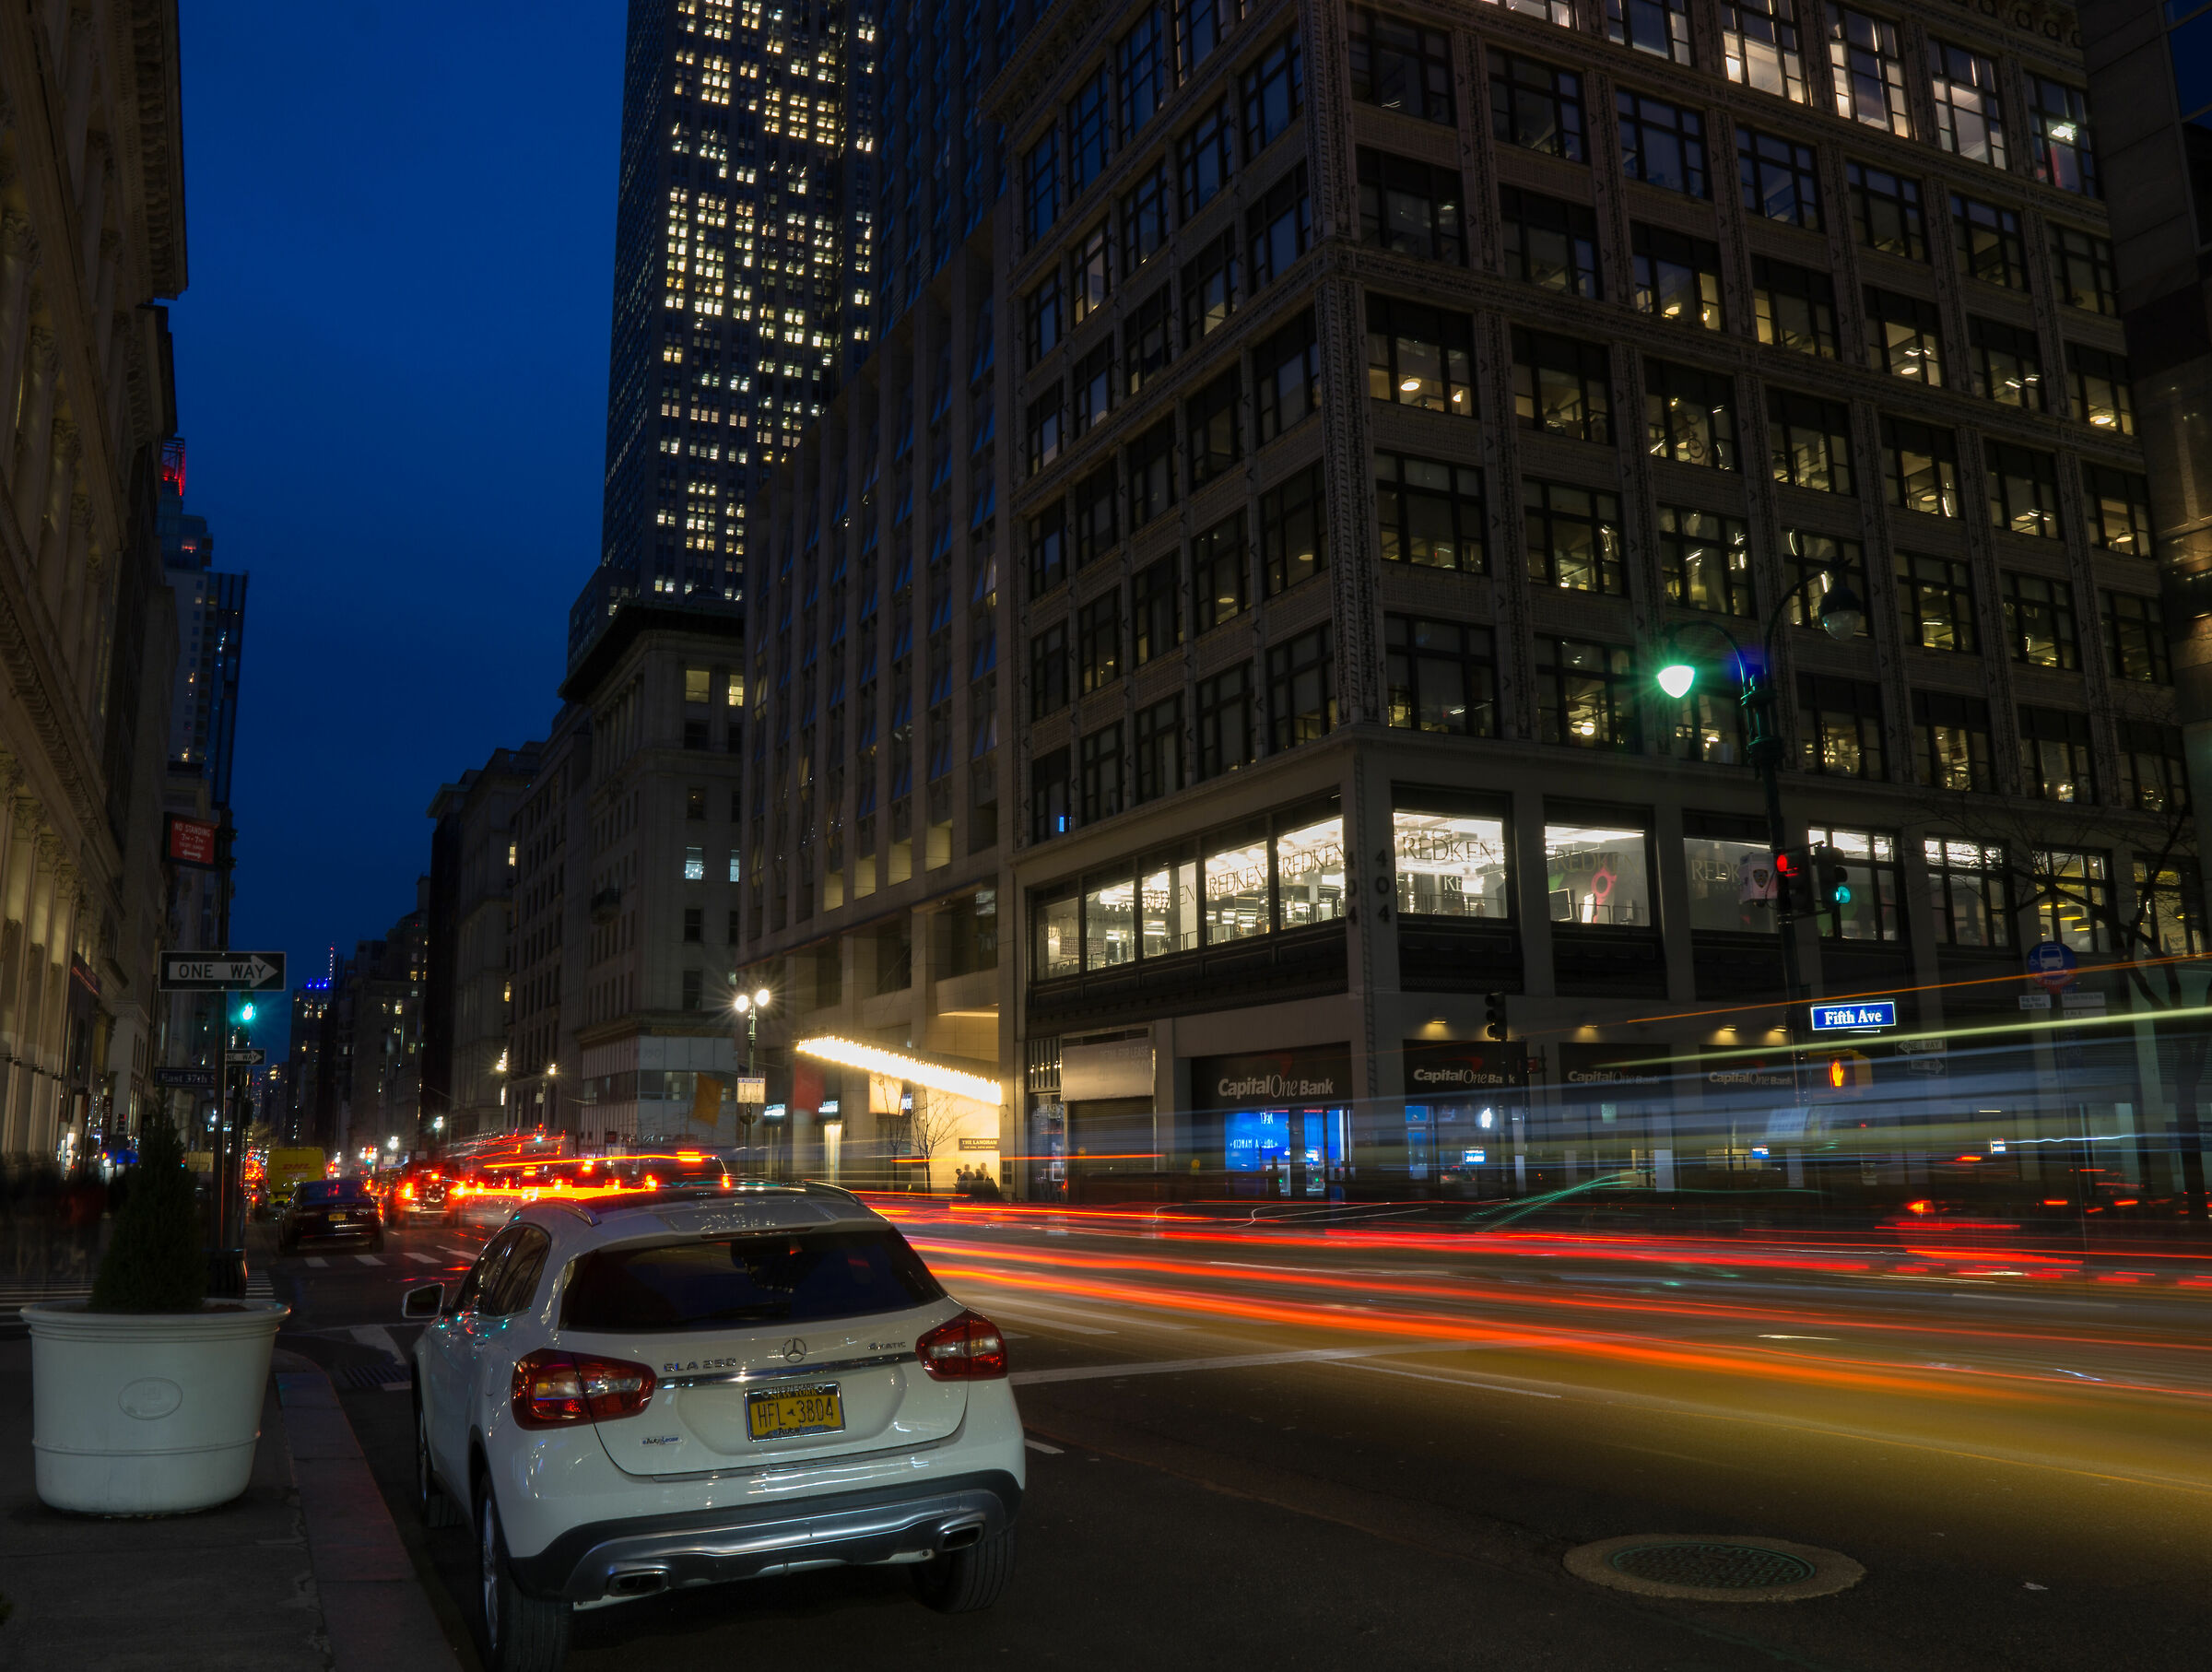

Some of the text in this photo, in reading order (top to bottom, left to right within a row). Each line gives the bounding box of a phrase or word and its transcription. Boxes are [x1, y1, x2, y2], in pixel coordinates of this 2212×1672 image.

[175, 822, 211, 838] NO STANDING
[1403, 836, 1498, 865] REDKEN
[1554, 848, 1641, 875] REDKEN
[1691, 858, 1740, 882] REDK
[1209, 862, 1266, 898] REDKEN
[179, 964, 266, 979] ONE WAY
[1824, 1009, 1882, 1026] Fifth Ave
[1903, 1040, 1940, 1050] ONE WAY
[162, 1073, 216, 1083] East 37th S
[1488, 1073, 1516, 1084] Bak
[1635, 1075, 1660, 1085] Bank
[1771, 1075, 1794, 1086] Bank
[1300, 1077, 1335, 1096] Bank
[664, 1358, 736, 1372] GLA 250
[771, 1388, 818, 1401] NEW YORK
[757, 1396, 834, 1429] HFL 3804
